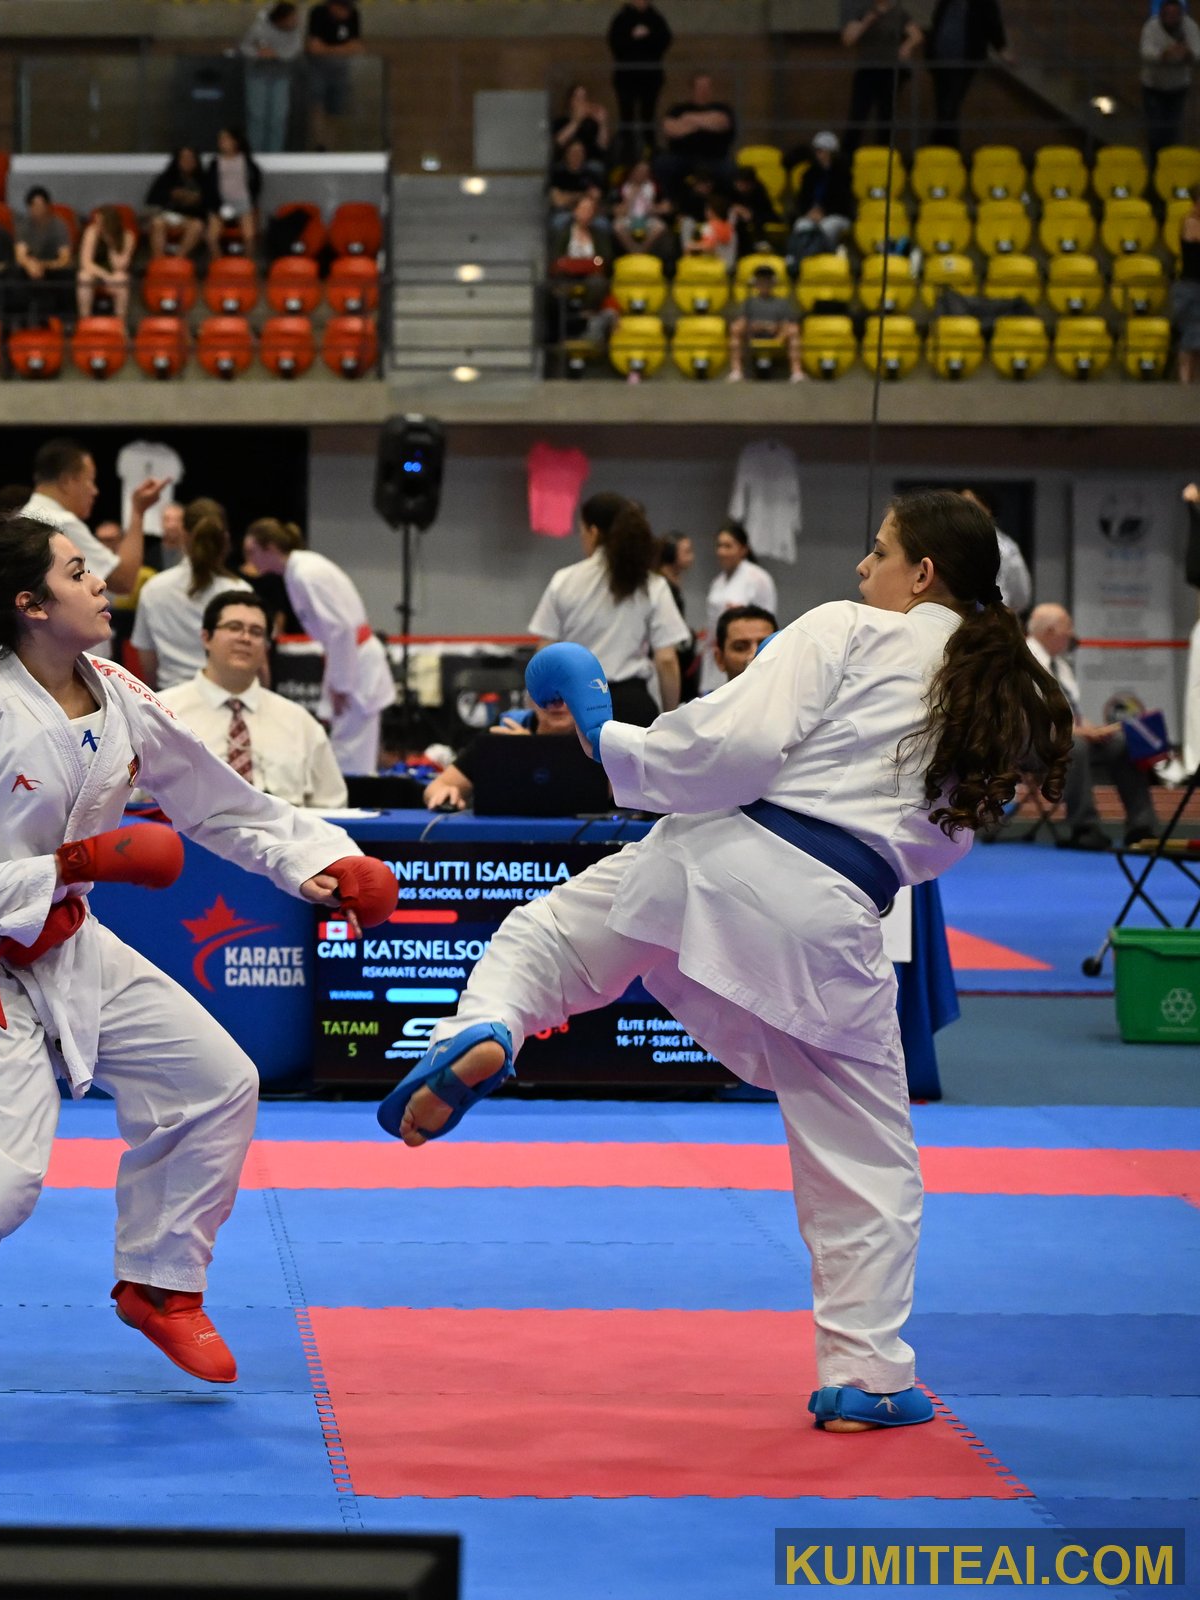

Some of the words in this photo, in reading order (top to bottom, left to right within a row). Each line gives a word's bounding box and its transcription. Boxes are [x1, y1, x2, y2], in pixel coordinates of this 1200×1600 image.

[476, 861, 570, 882] ISABELLA
[418, 887, 464, 900] SCHOOL
[465, 888, 480, 900] OF
[482, 888, 523, 900] KARATE
[225, 946, 304, 967] KARATE
[317, 941, 356, 959] CAN
[225, 967, 306, 987] CANADA
[418, 966, 466, 978] CANADA
[322, 1021, 379, 1036] TATAMI
[616, 1035, 646, 1046] 16-17
[348, 1043, 357, 1057] 5
